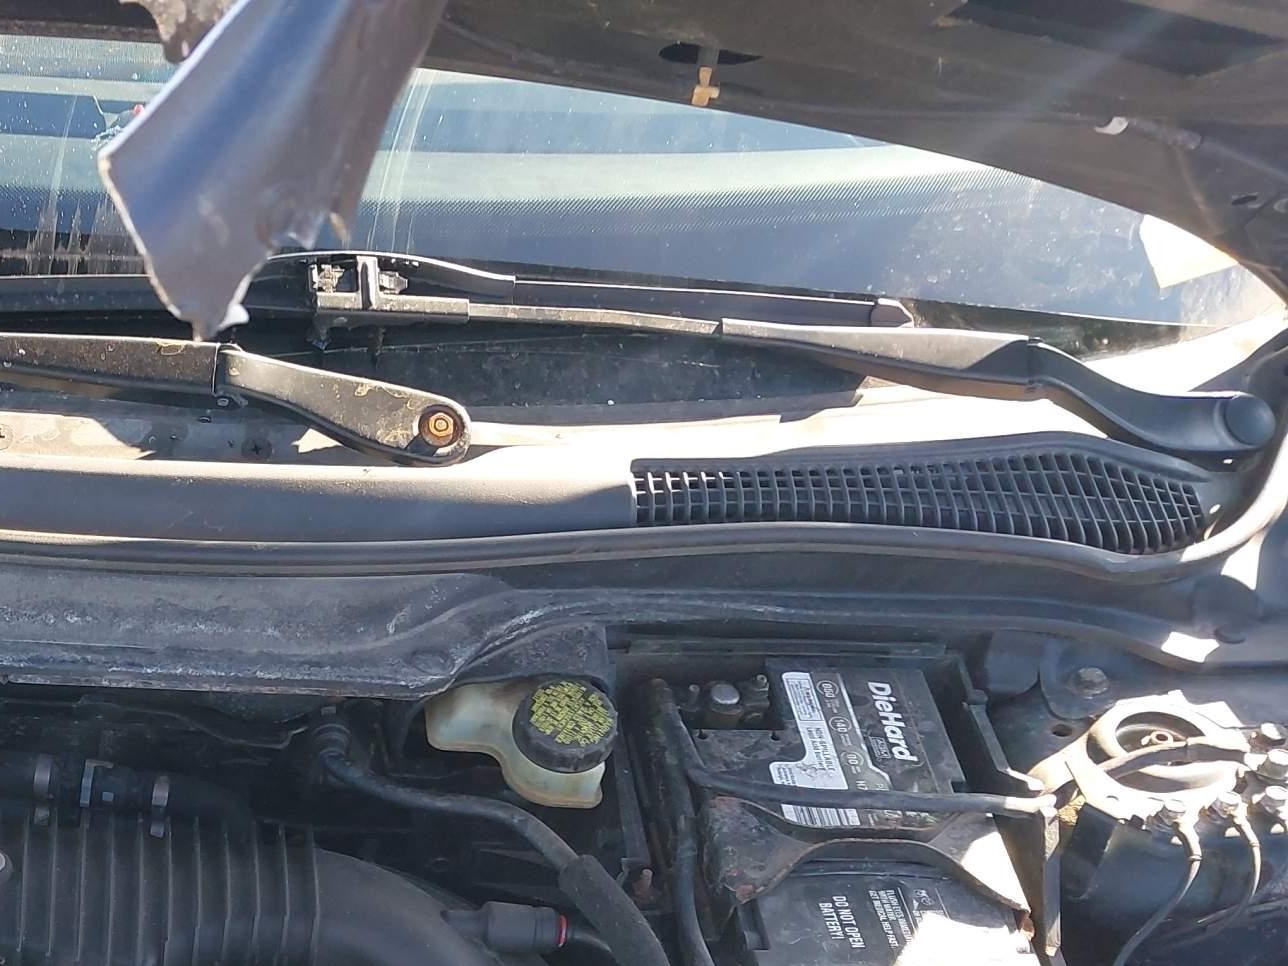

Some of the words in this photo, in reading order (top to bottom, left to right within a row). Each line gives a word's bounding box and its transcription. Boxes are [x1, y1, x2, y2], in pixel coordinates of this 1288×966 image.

[868, 681, 919, 762] DieHard
[832, 895, 849, 908] DO
[819, 903, 844, 939] BATTERY!
[838, 910, 854, 926] NOT
[845, 927, 866, 948] OPEN
